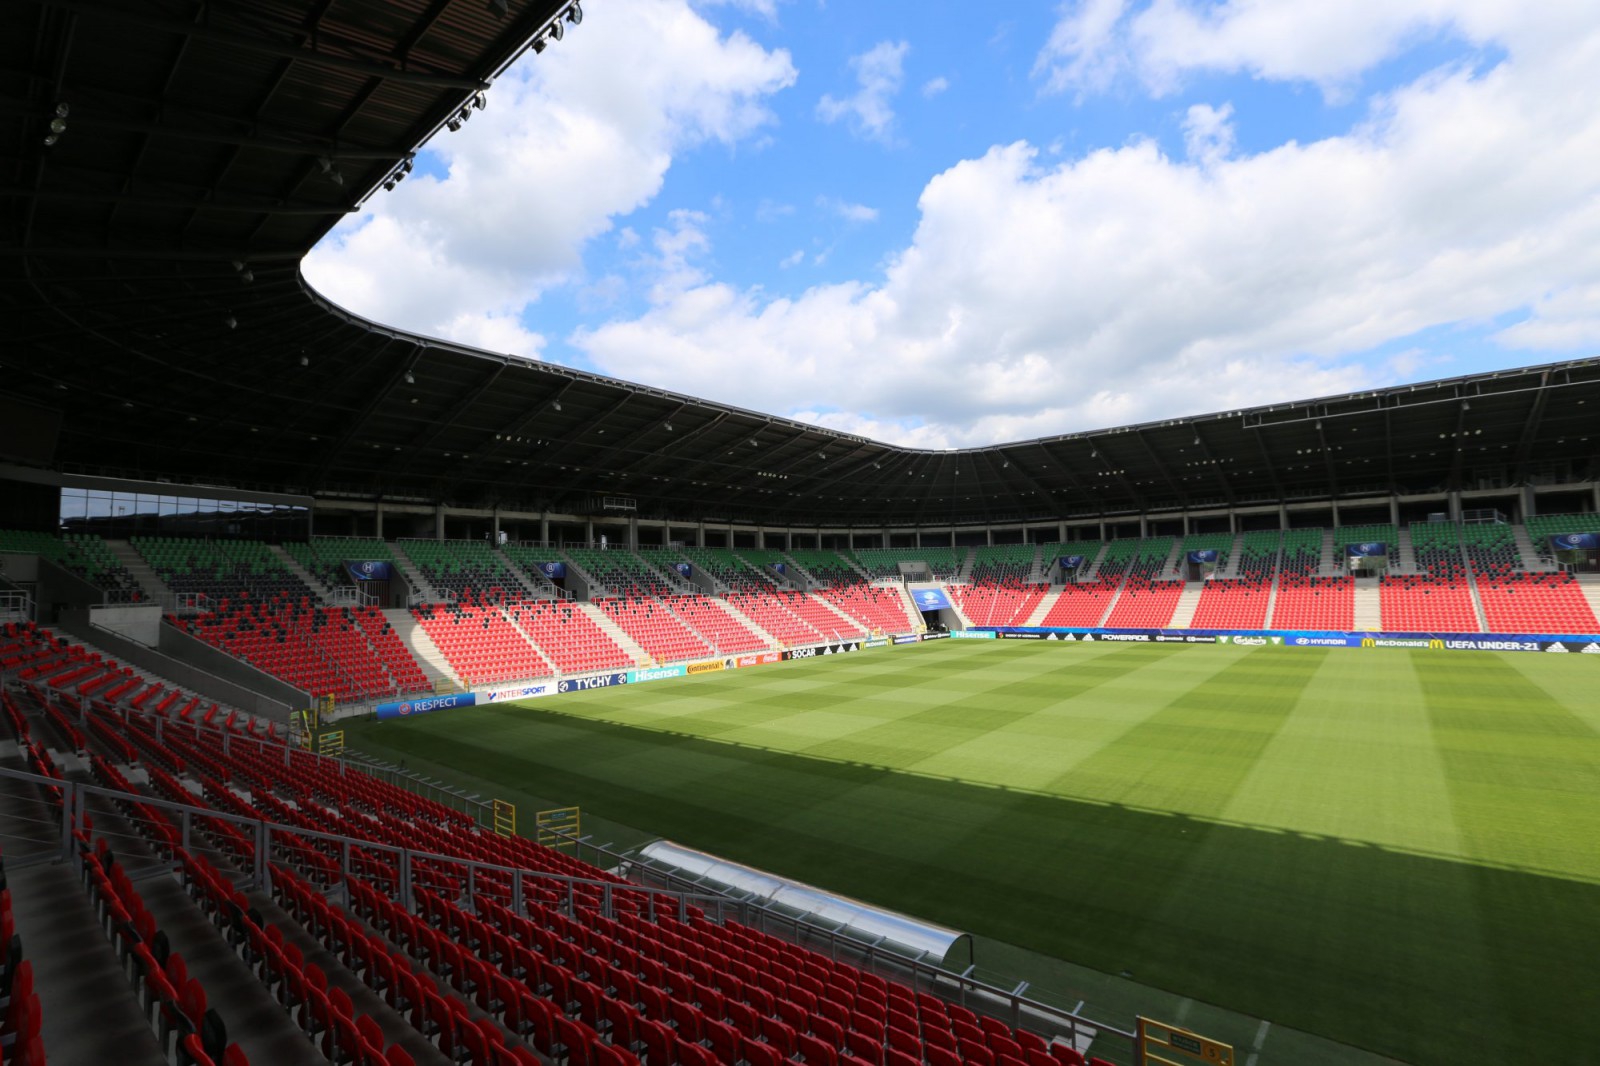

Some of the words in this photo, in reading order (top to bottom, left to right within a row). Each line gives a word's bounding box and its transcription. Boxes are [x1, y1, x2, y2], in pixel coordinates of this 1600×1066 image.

[1375, 639, 1429, 647] McDonald's
[1446, 640, 1477, 649] UEFA
[1478, 641, 1539, 651] UNDER-21
[792, 648, 816, 659] SOCAR
[687, 662, 720, 674] Continental
[635, 668, 680, 682] Hisense
[575, 675, 612, 690] TYCHY
[497, 686, 546, 700] INTERSPORT
[414, 697, 458, 712] RESPECT
